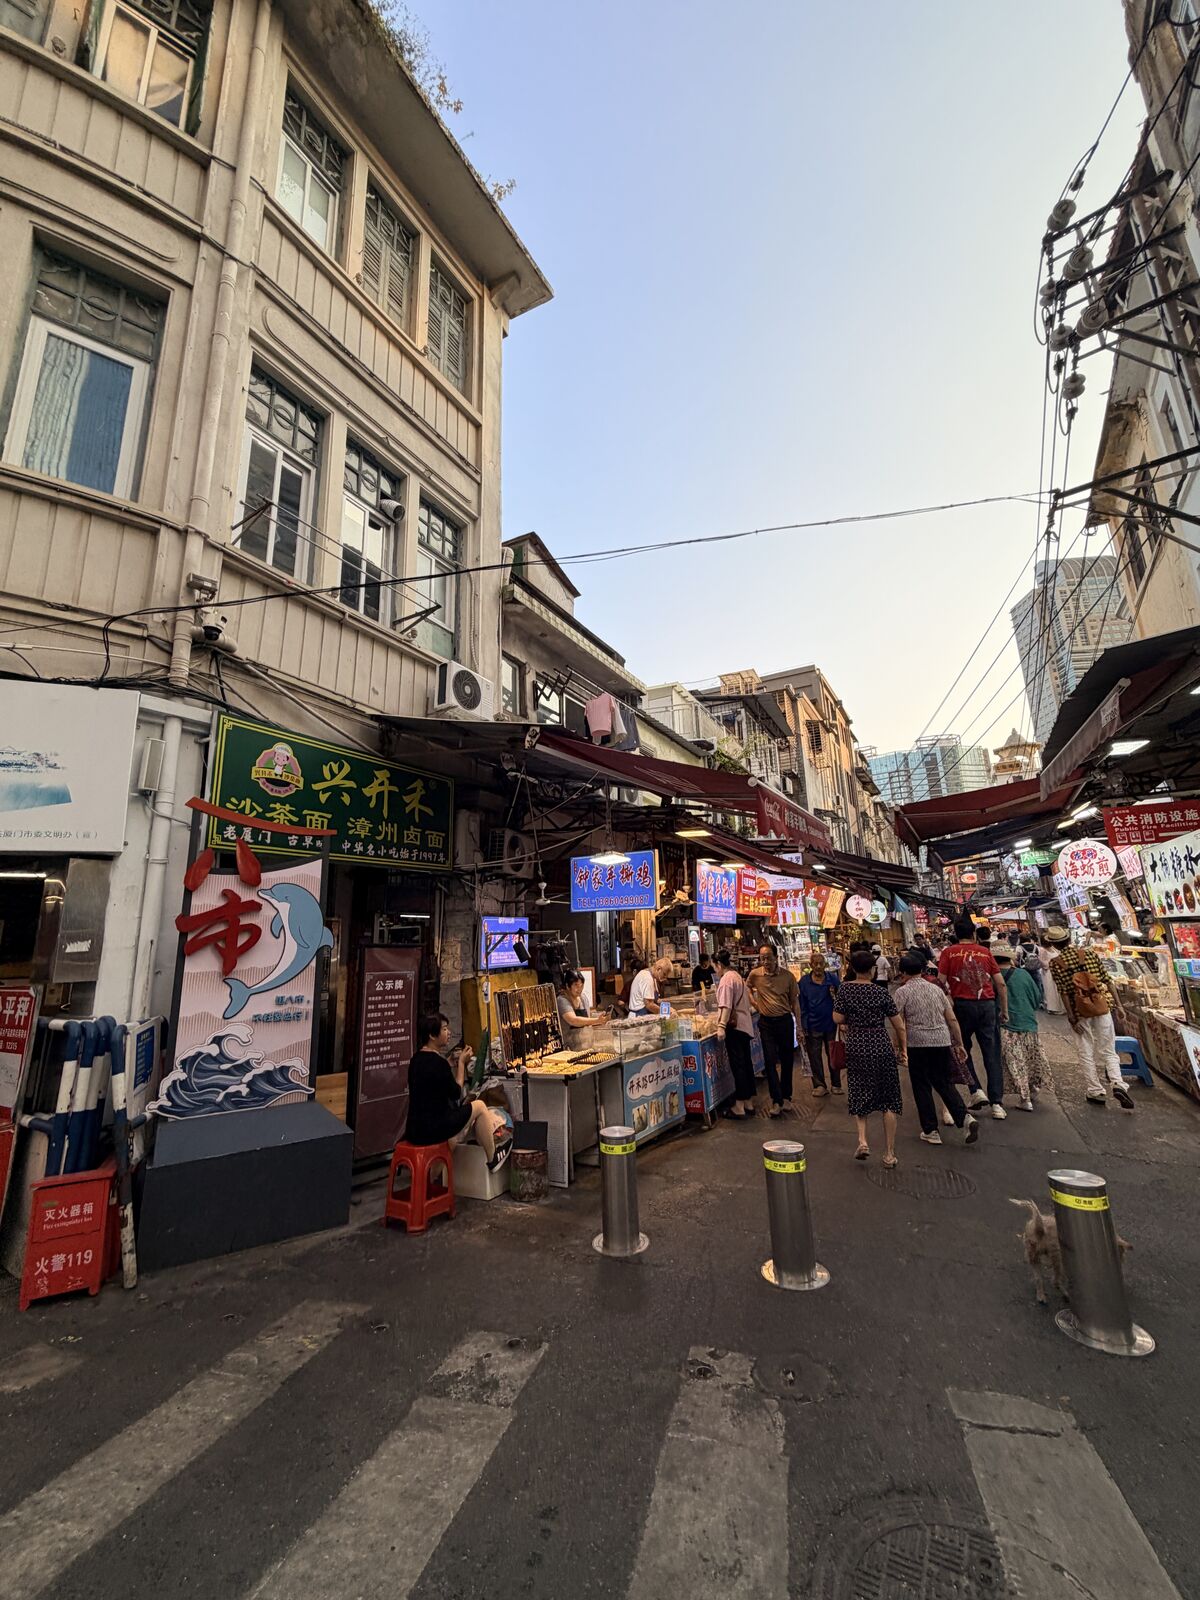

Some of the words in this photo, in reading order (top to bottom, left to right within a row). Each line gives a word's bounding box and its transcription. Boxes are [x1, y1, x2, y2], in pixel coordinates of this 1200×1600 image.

[311, 760, 434, 823] 兴开禾
[225, 797, 332, 830] 沙茶面
[1110, 808, 1200, 827] 公共消防设施
[223, 824, 271, 844] 老厦门
[346, 816, 445, 849] 漳州卤面
[341, 839, 446, 866] 中华名小吃始于1997年
[577, 860, 652, 893] 钟家手撕鸡
[1064, 856, 1112, 879] 海蛎煎
[375, 979, 404, 991] 公示牌
[0, 996, 31, 1025] 平秤
[44, 1202, 94, 1222] 灭火器箱
[34, 1249, 94, 1275] 火警119
